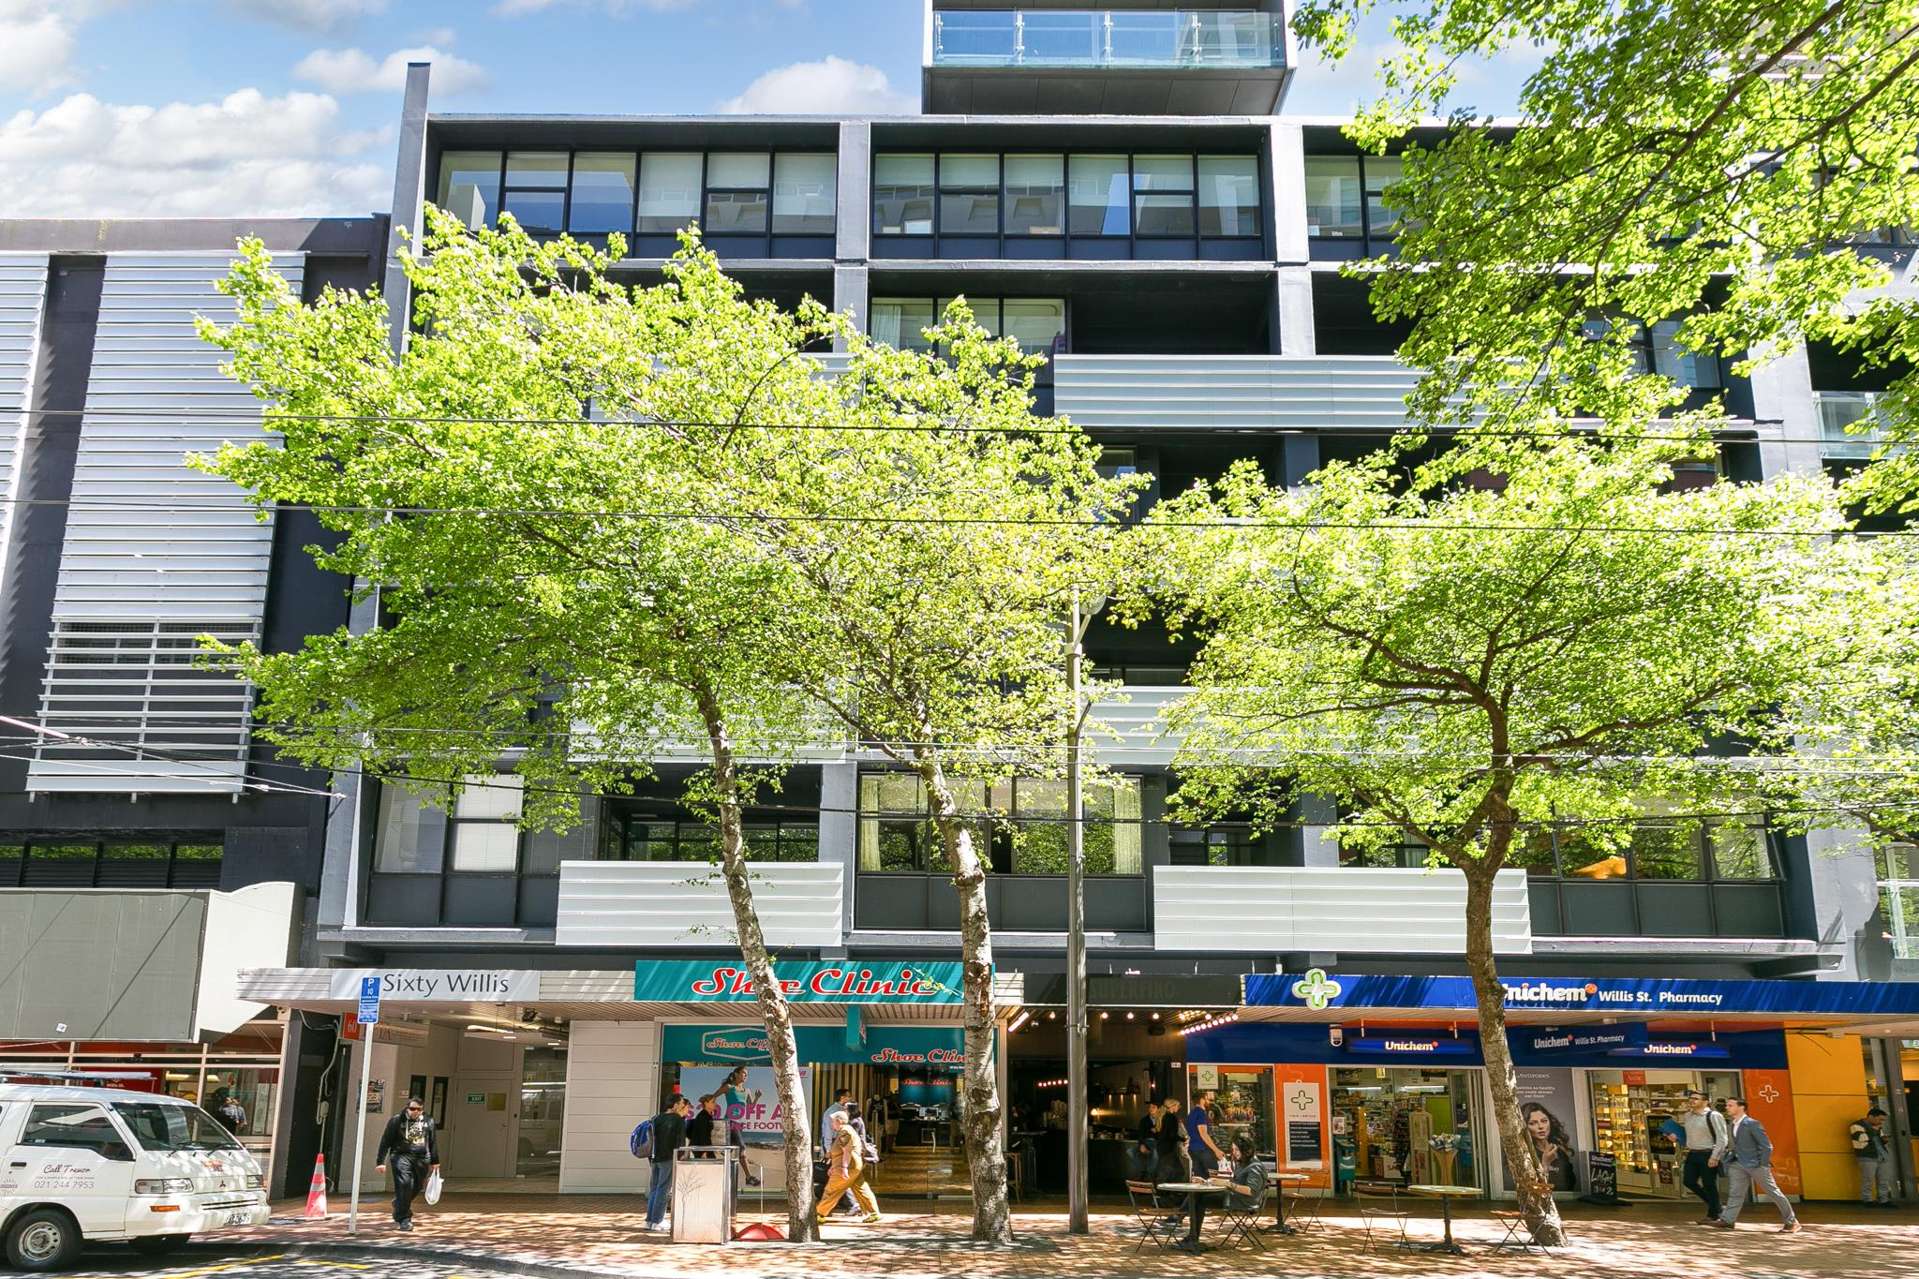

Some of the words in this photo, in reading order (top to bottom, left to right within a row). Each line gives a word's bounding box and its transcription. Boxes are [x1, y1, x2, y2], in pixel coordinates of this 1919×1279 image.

[368, 978, 375, 987] P
[382, 973, 439, 998] Sixty
[447, 973, 509, 993] Willis
[691, 967, 806, 995] She
[810, 968, 938, 996] Clinic
[1599, 990, 1634, 1002] Willis
[1636, 991, 1653, 1002] St.
[1659, 991, 1723, 1006] Pharmacy
[1384, 1040, 1435, 1051] Unichem
[1534, 1035, 1570, 1049] Unichem
[871, 1048, 926, 1063] Shoe
[927, 1048, 966, 1063] Clin
[726, 1103, 766, 1120] OFF
[43, 1163, 62, 1174] Call
[34, 1180, 50, 1189] 021
[53, 1180, 70, 1189] 244
[73, 1180, 95, 1189] 7953
